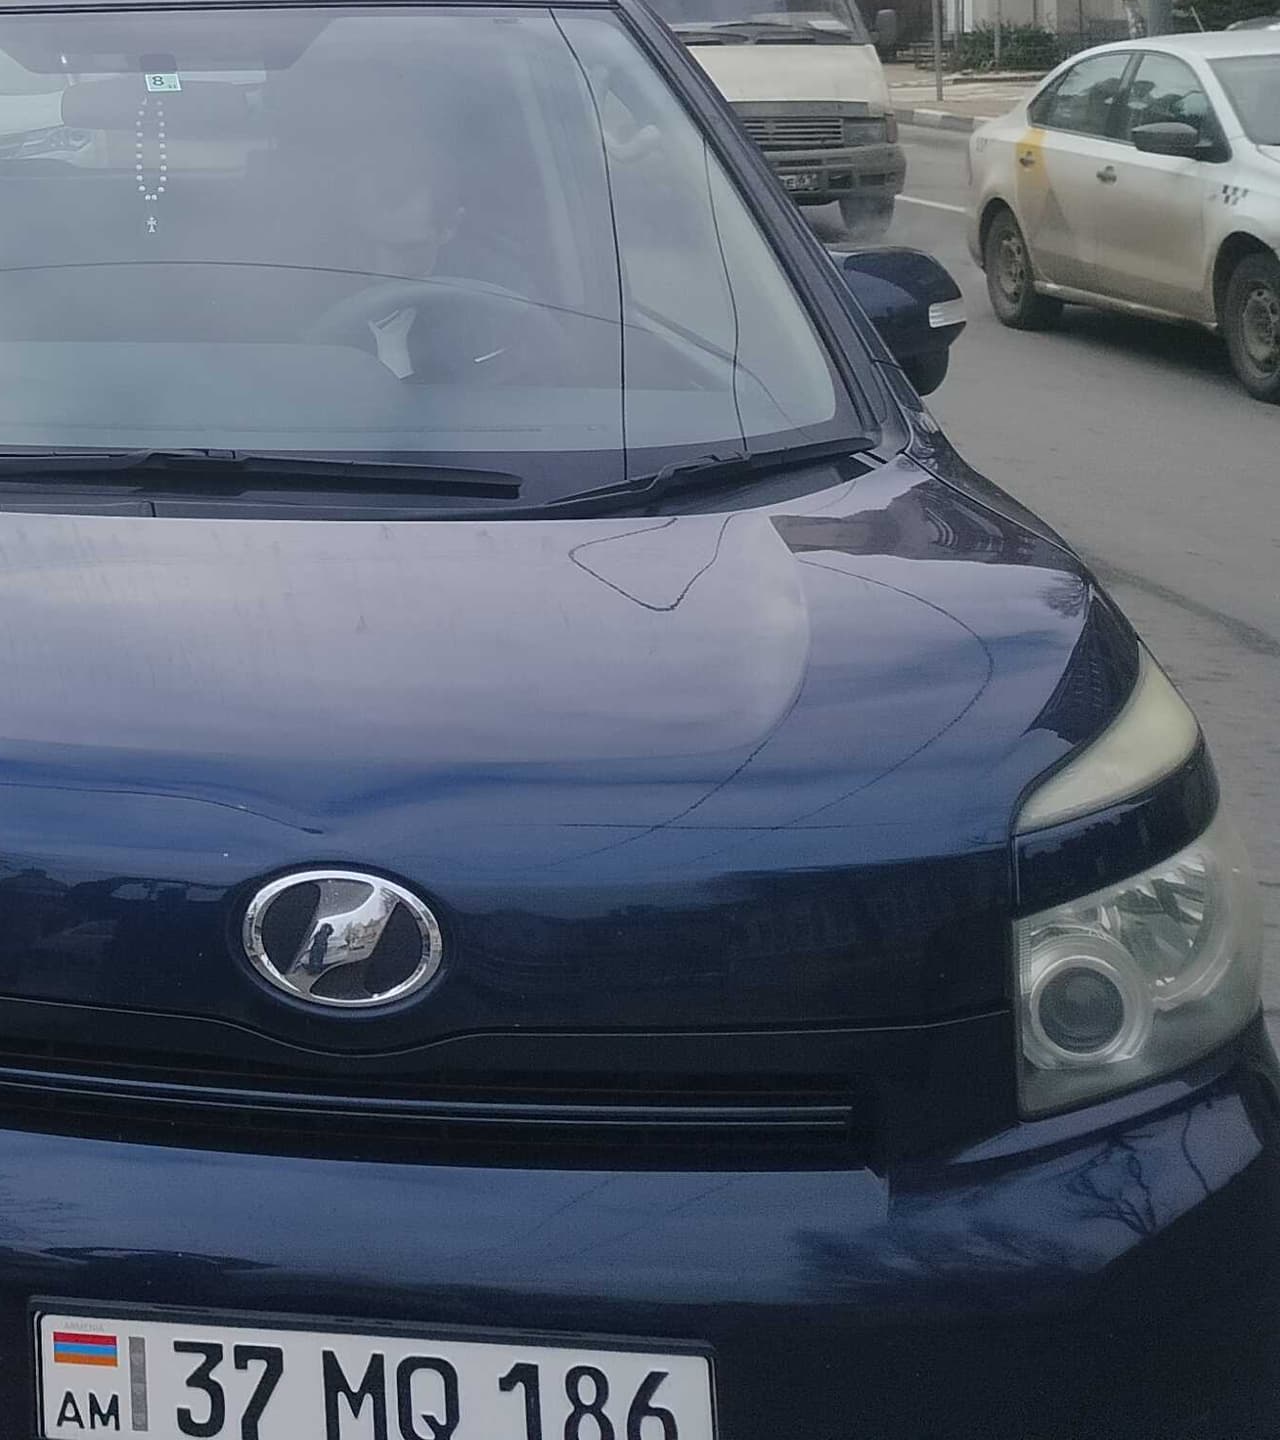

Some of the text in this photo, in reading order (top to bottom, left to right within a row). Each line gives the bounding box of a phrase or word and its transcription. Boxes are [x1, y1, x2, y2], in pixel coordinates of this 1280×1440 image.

[151, 75, 165, 87] 8
[173, 1340, 678, 1440] 37 MQ 186
[56, 1391, 121, 1431] AM
